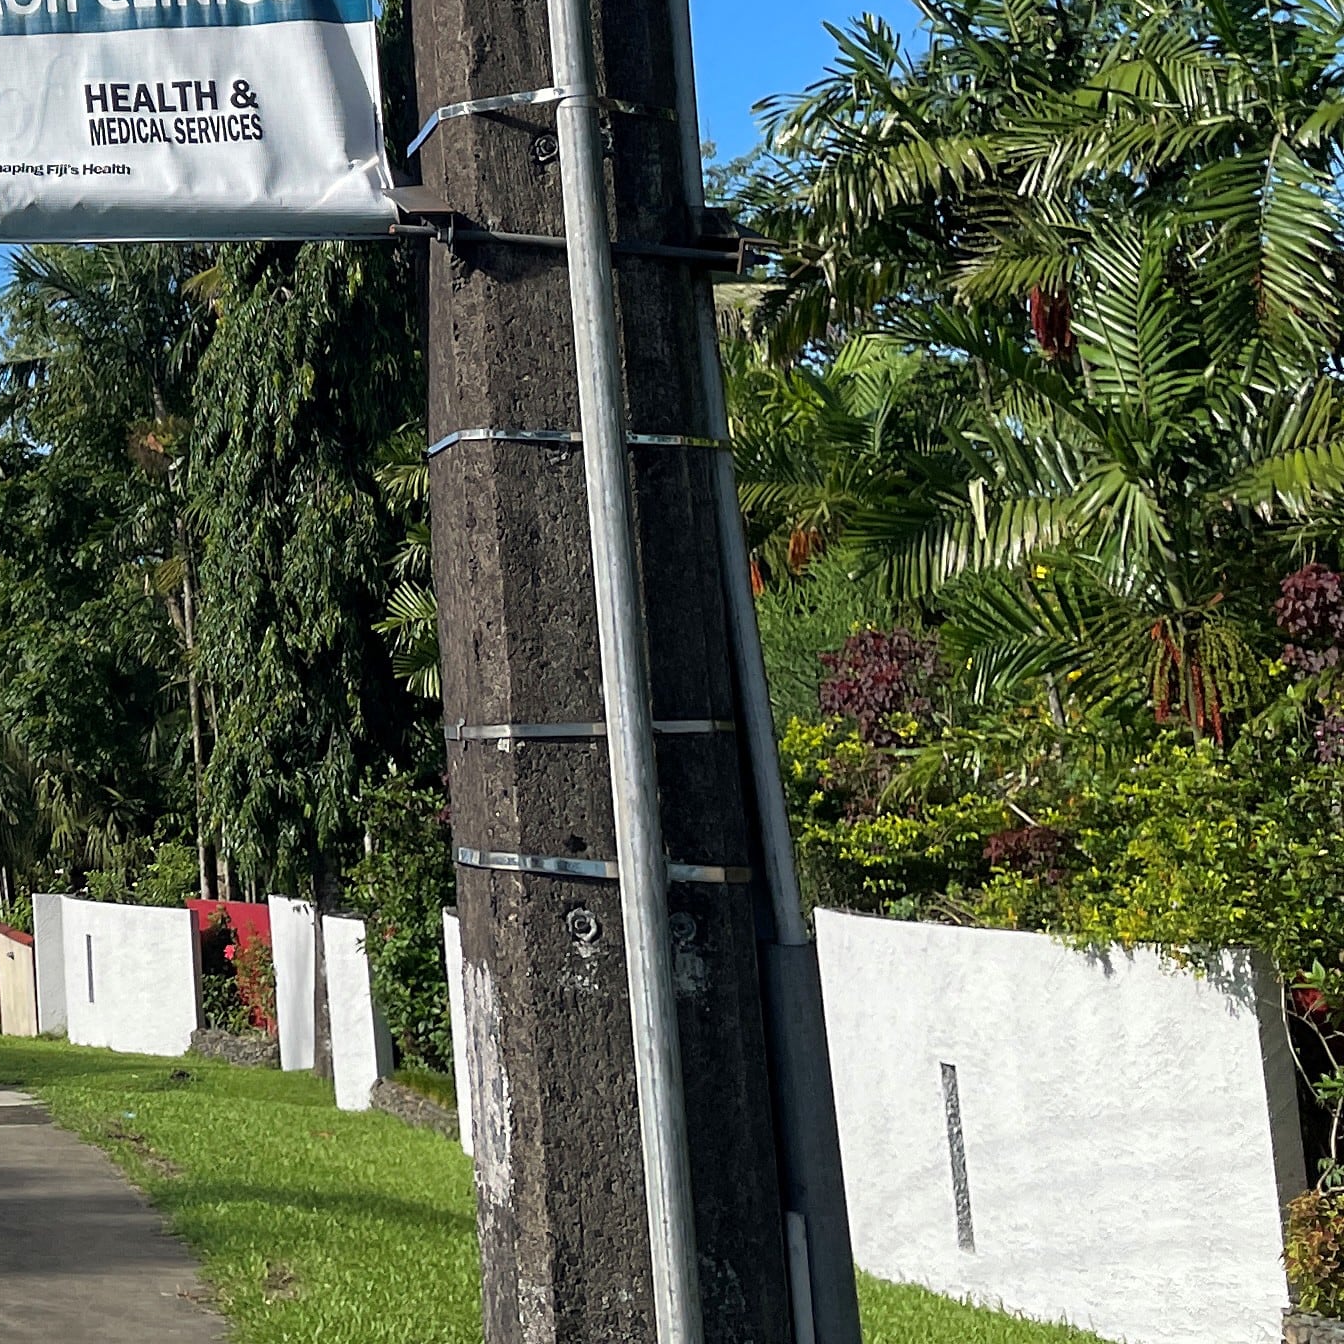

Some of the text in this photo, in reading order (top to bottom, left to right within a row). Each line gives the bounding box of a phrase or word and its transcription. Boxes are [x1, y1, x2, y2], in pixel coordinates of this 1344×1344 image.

[84, 78, 259, 114] HEALTH &
[88, 113, 264, 146] MEDICAL SERVICES
[46, 163, 79, 177] Fiji's
[82, 163, 132, 175] Health
